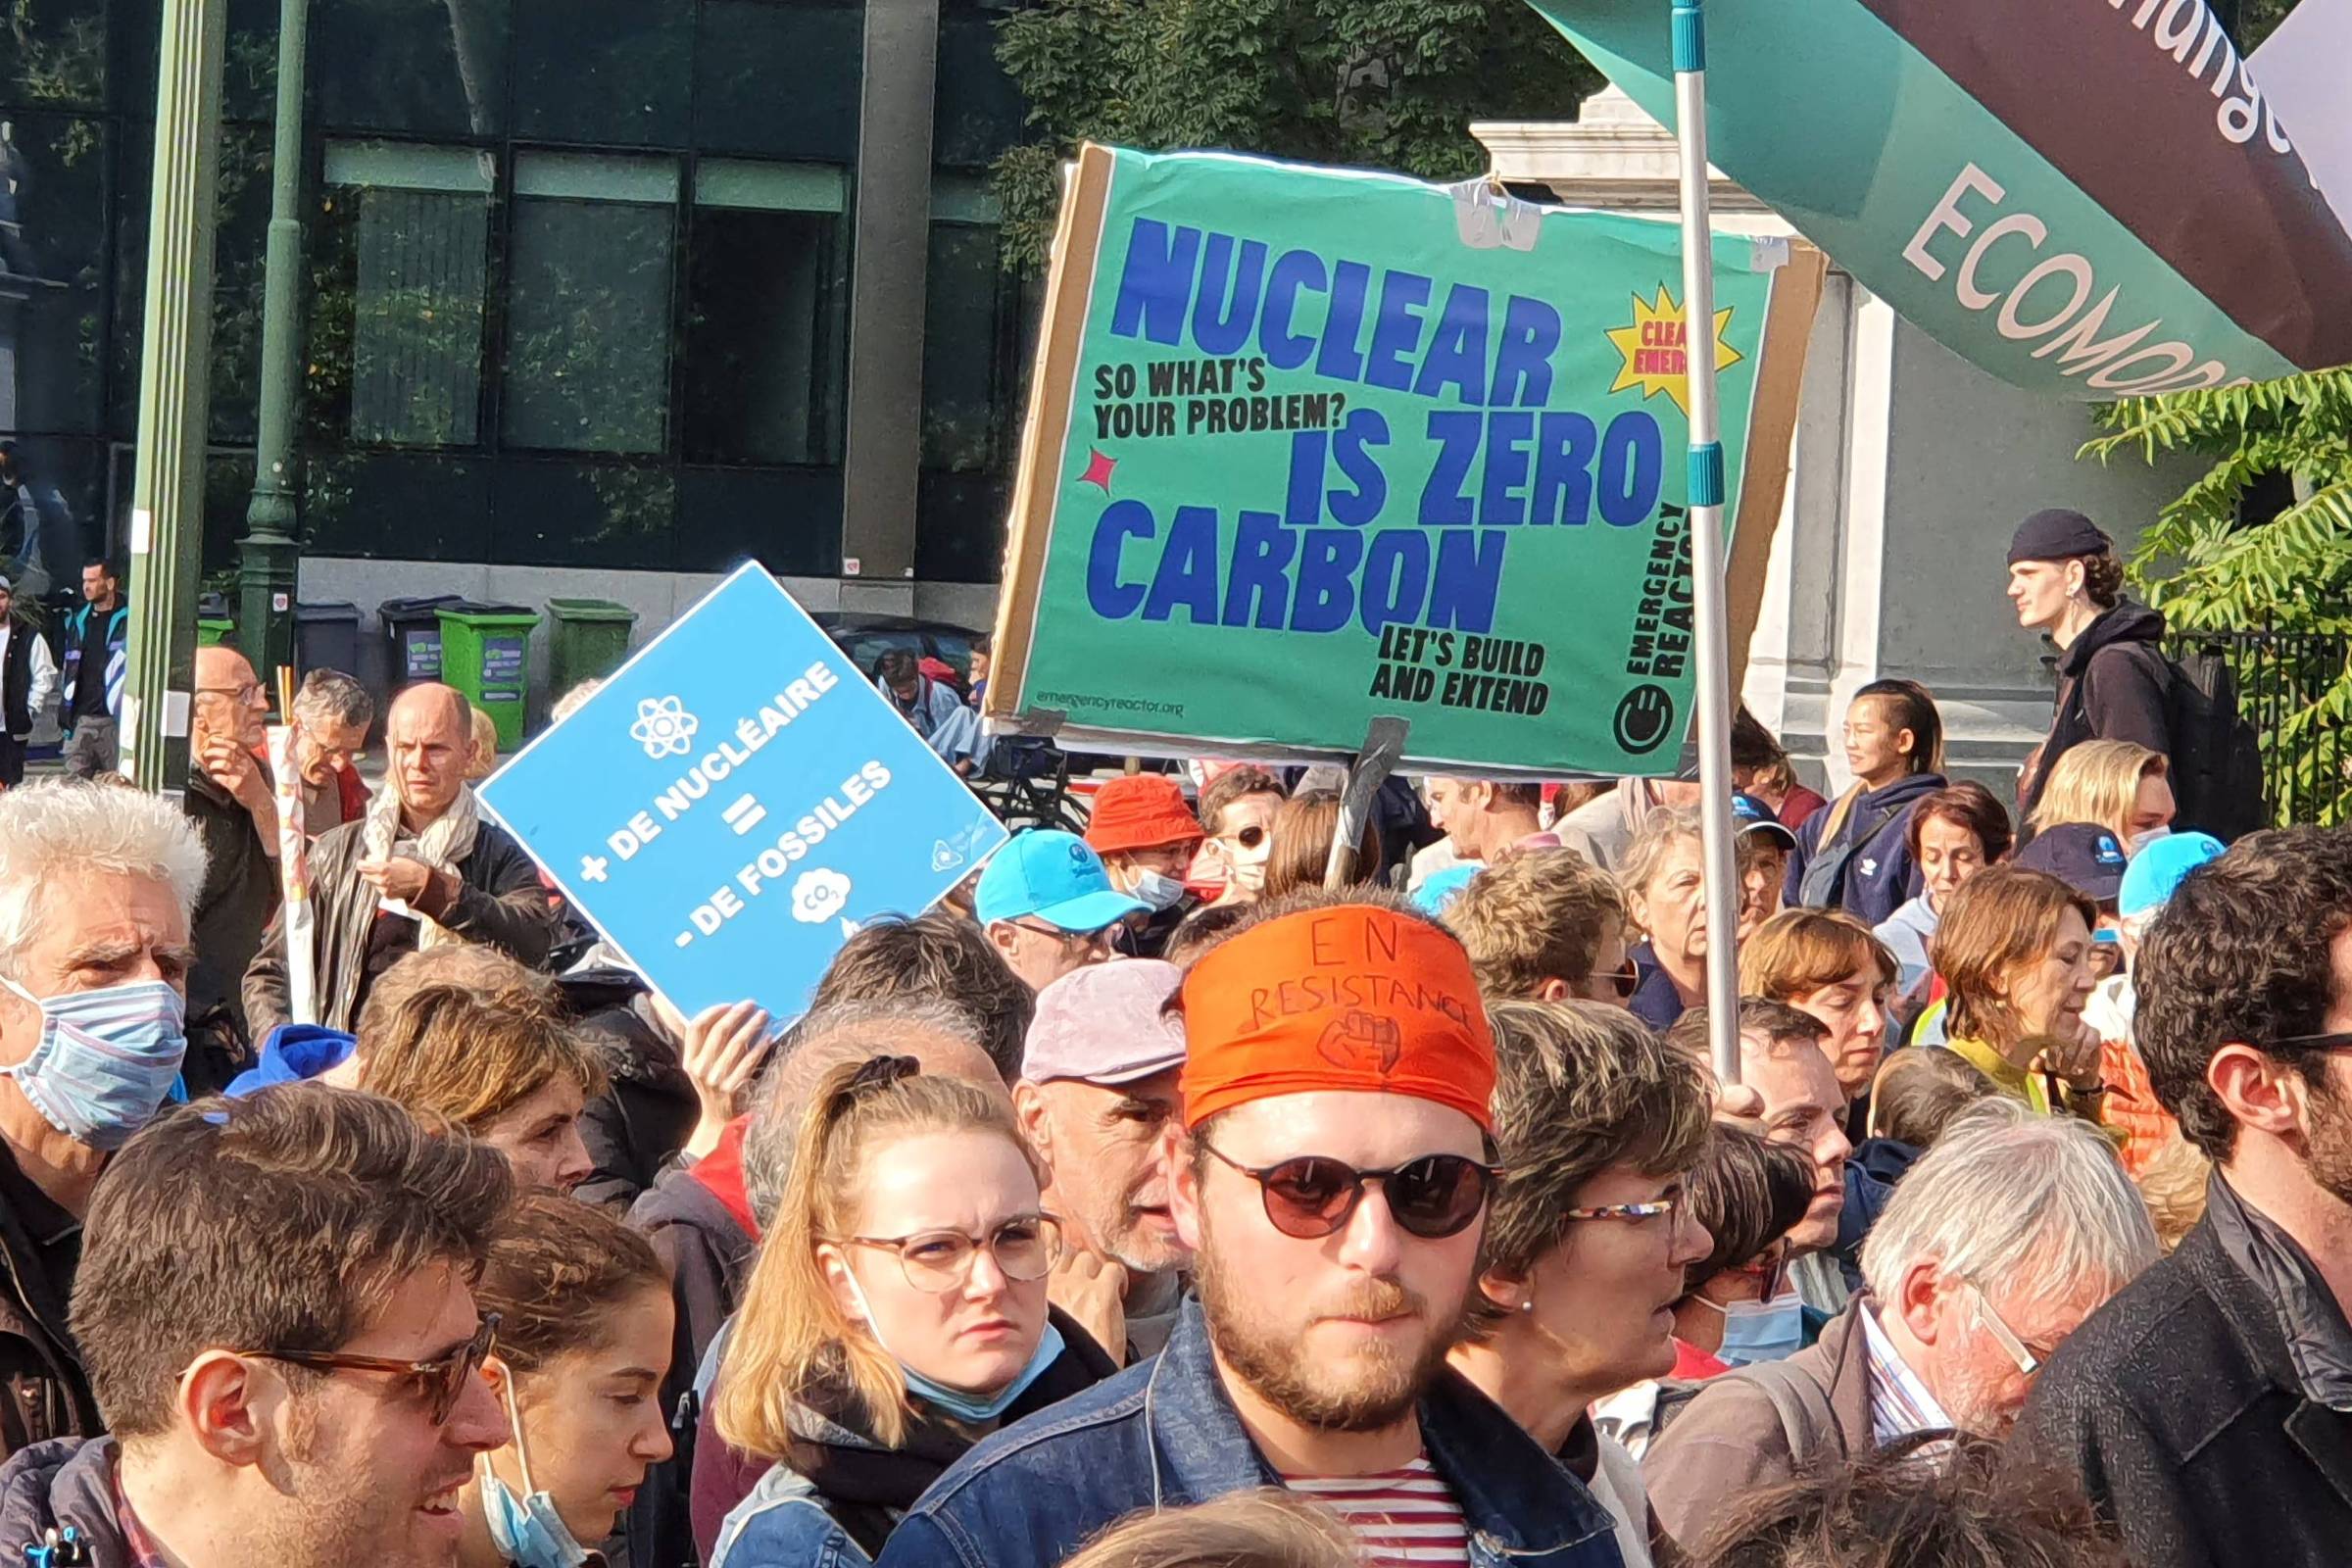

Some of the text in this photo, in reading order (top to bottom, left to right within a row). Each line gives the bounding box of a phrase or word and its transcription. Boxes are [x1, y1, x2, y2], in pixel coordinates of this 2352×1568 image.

[1110, 216, 1562, 408] NUCLEAR
[1642, 320, 1687, 347] CLEA
[1094, 357, 1265, 400] SO WHAT'S
[1633, 349, 1687, 374] ENER
[1095, 392, 1347, 439] YOUR PROBLEM?
[1285, 407, 1663, 527] IS ZERO
[1086, 499, 1507, 637] CARBON
[1626, 501, 1685, 675] EMERGENCY
[1377, 624, 1545, 677] LET'S BUILD
[1036, 691, 1185, 718] emergencyreactor.org
[1368, 663, 1549, 716] AND EXTEND
[607, 810, 663, 863] DE
[653, 661, 840, 820] NUCLÉAIRE
[689, 886, 744, 937] DE
[736, 760, 893, 897] FOSSILES
[1311, 916, 1397, 966] EN
